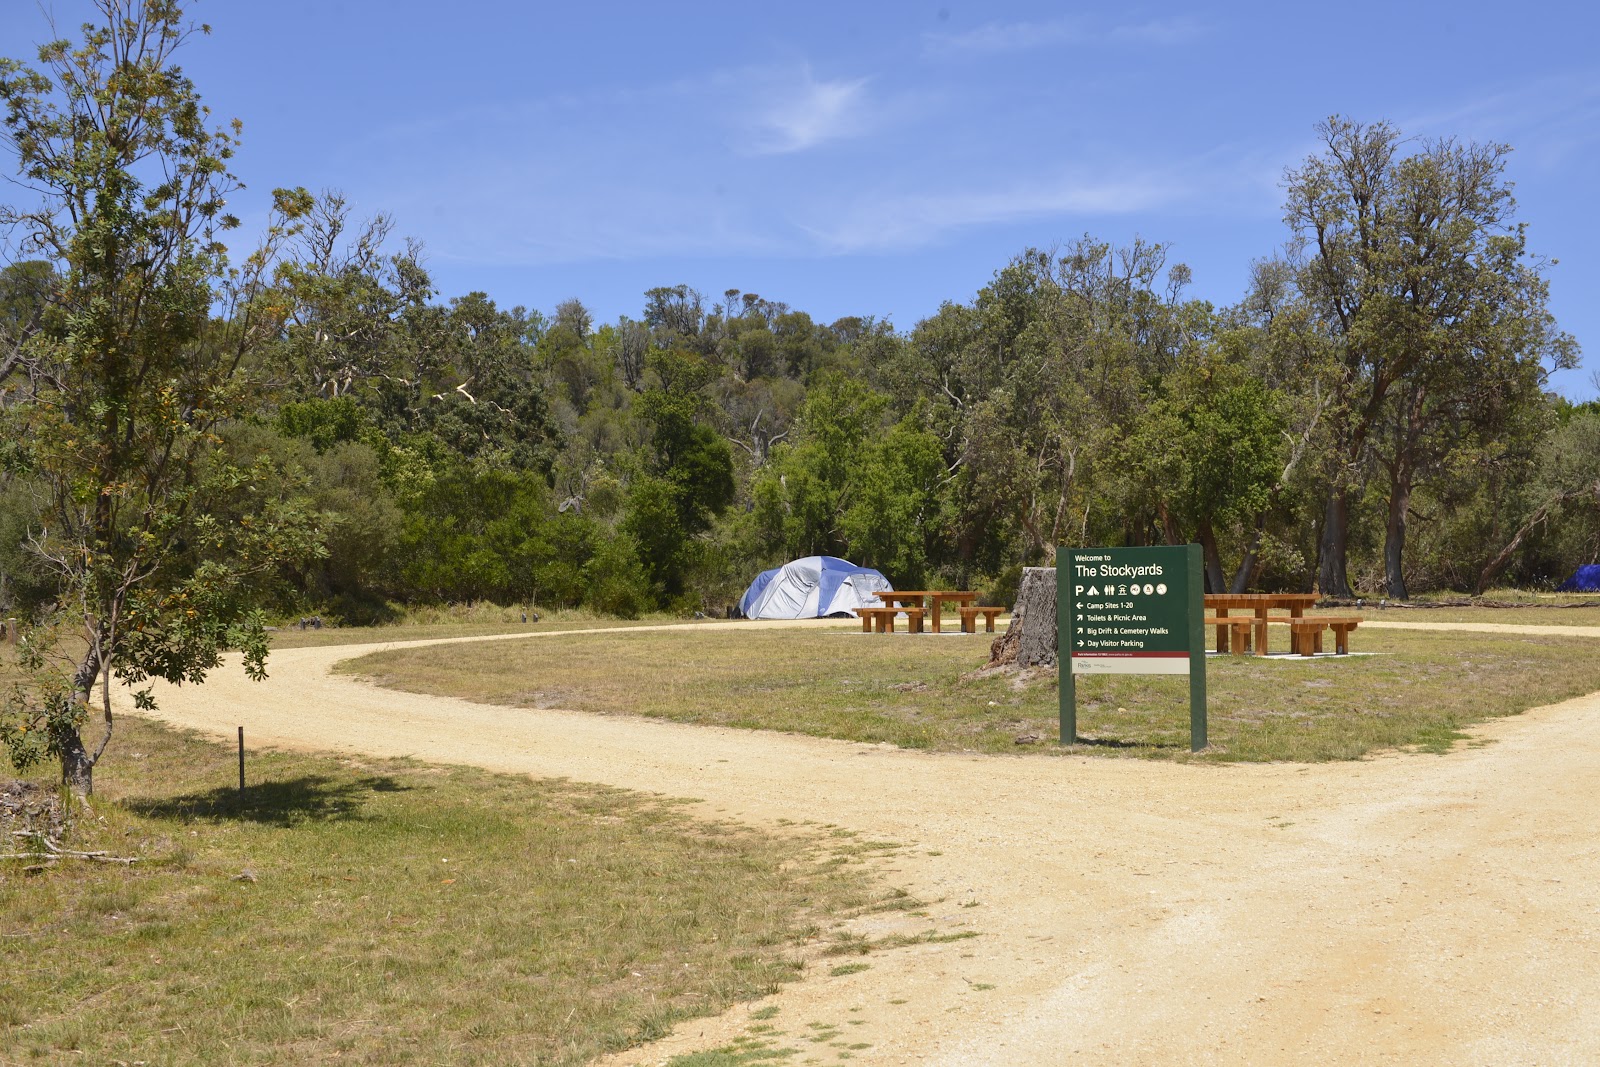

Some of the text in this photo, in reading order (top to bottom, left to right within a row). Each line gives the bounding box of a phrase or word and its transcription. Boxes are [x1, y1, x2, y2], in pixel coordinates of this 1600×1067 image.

[1075, 564, 1163, 578] The Stockyards
[1076, 585, 1084, 596] P
